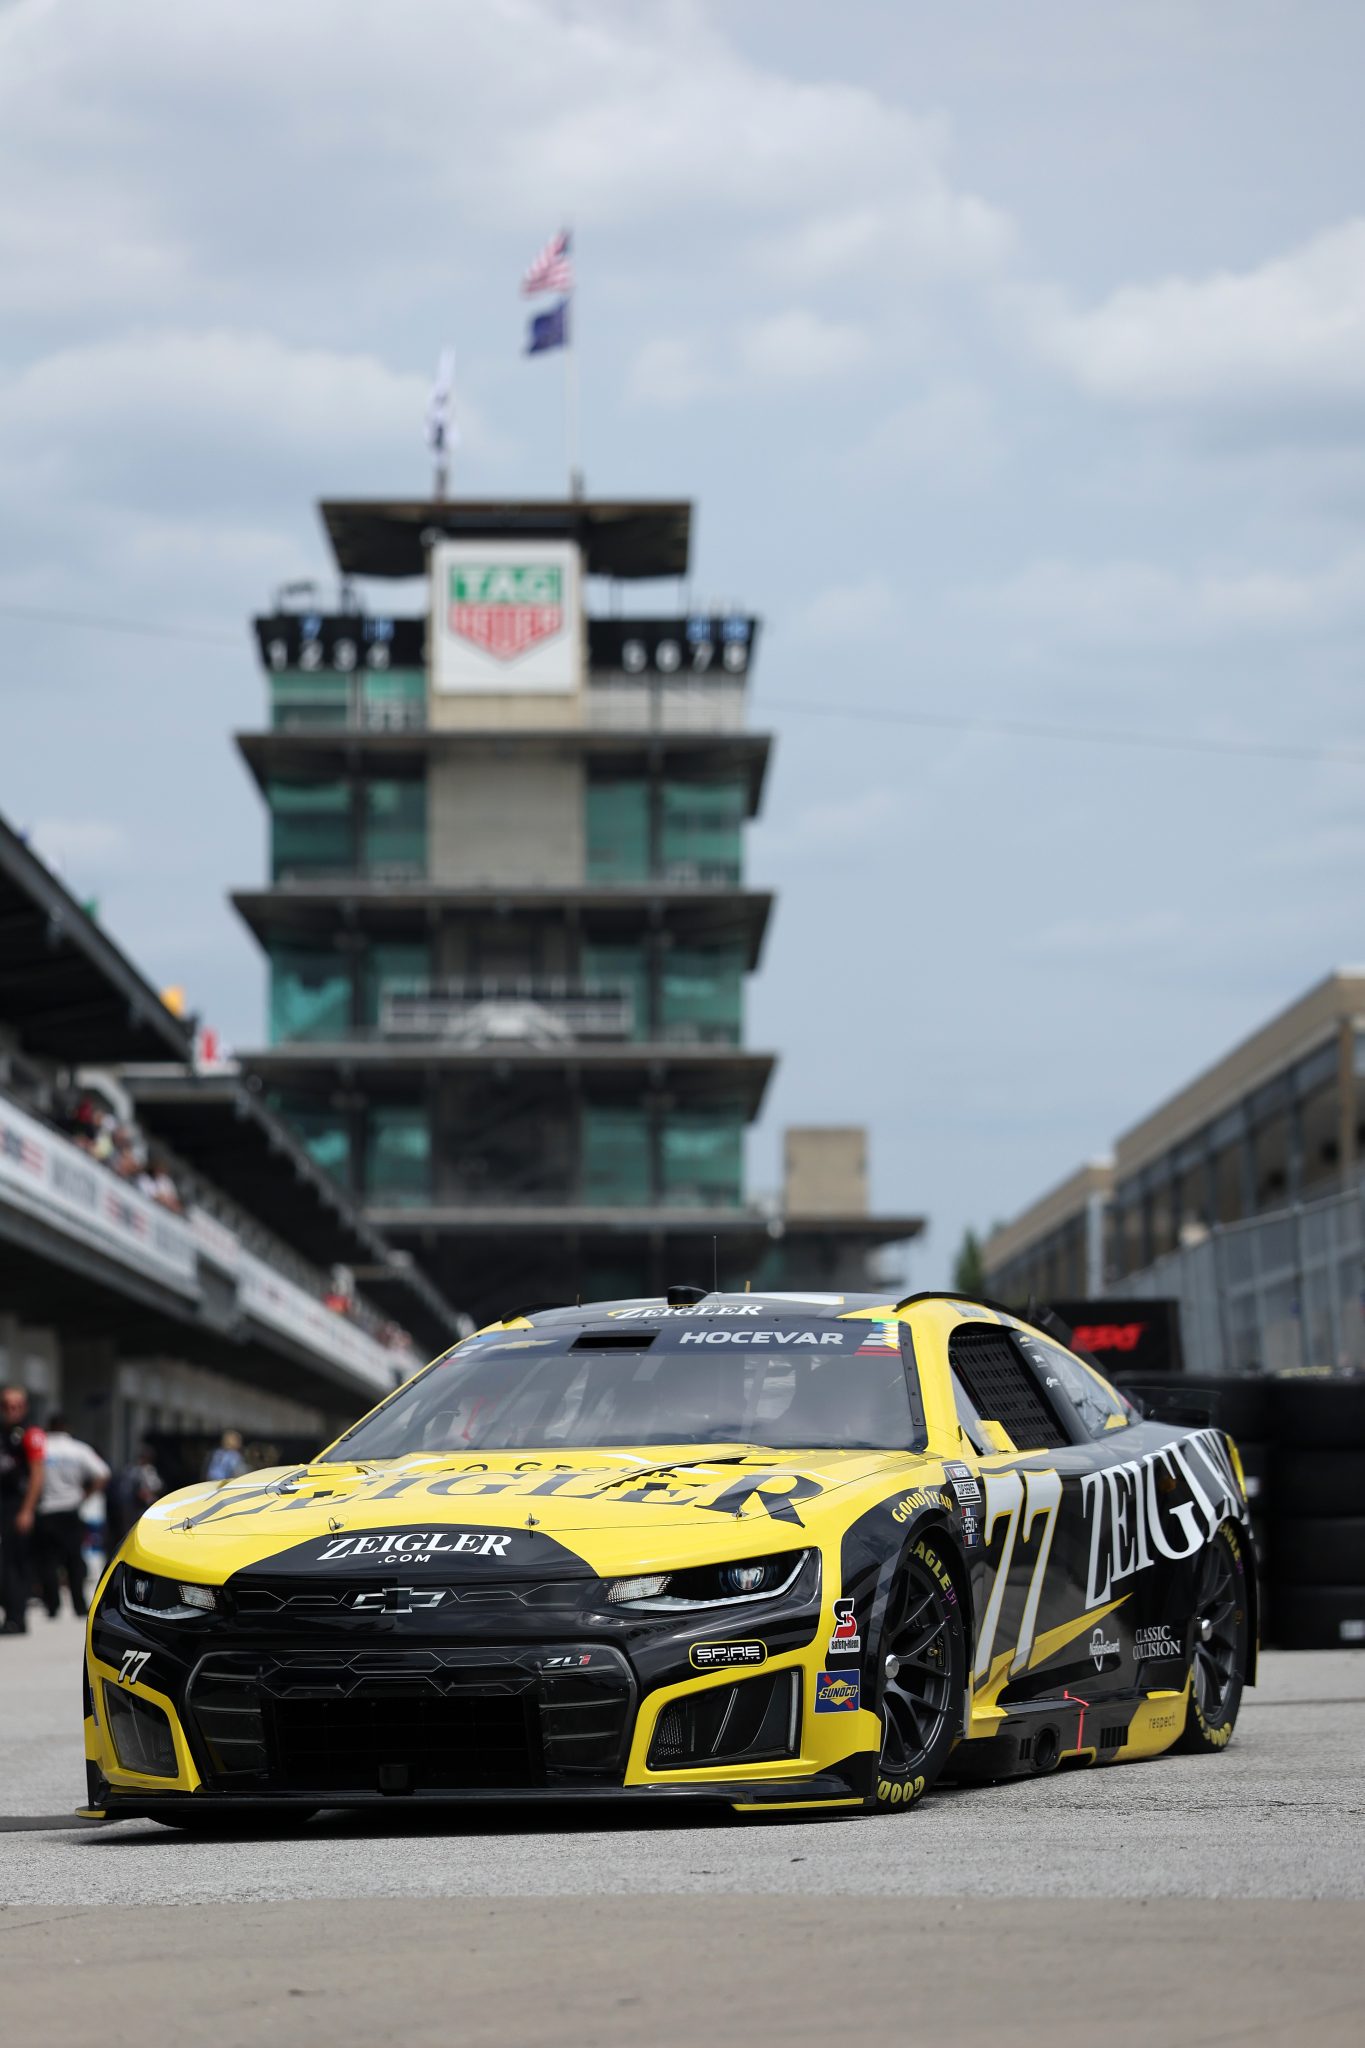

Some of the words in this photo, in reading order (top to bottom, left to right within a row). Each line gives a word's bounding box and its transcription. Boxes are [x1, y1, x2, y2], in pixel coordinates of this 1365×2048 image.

[454, 568, 557, 602] TAG
[614, 1305, 763, 1320] ZEIGLER
[680, 1331, 844, 1345] HOCEVAR
[164, 1473, 824, 1531] ZEIGLER
[316, 1533, 512, 1561] ZEIGLER
[378, 1554, 431, 1564] .COM
[909, 1540, 952, 1591] AGLE
[974, 1468, 1063, 1682] 77
[1135, 1625, 1171, 1644] CLASSIC
[697, 1646, 760, 1660] SPIRE
[1132, 1640, 1181, 1660] COLLISION
[119, 1649, 152, 1684] 77
[543, 1654, 592, 1668] ZL1
[820, 1685, 857, 1699] SUNOCO
